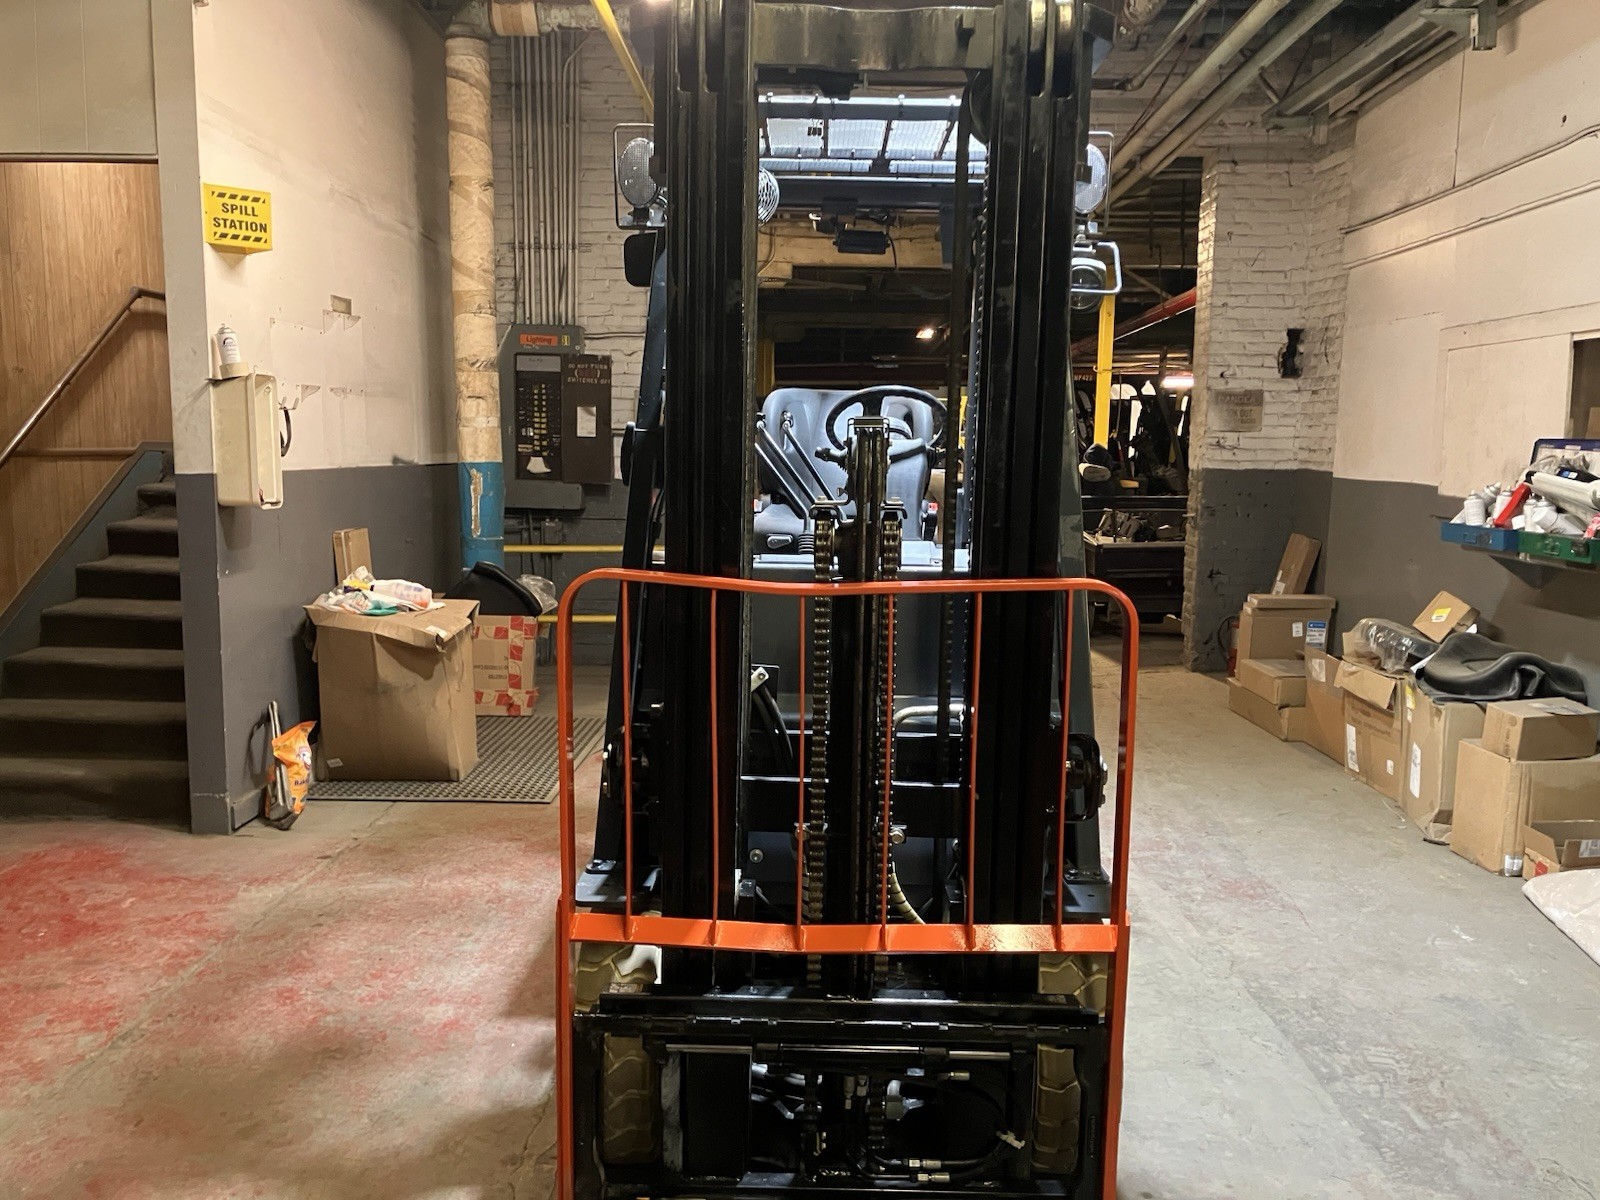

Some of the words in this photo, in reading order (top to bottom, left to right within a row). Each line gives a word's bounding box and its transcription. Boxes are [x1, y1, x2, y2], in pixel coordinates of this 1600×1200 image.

[221, 202, 258, 217] SPILL
[213, 217, 267, 233] STATION
[526, 335, 552, 345] Lighting
